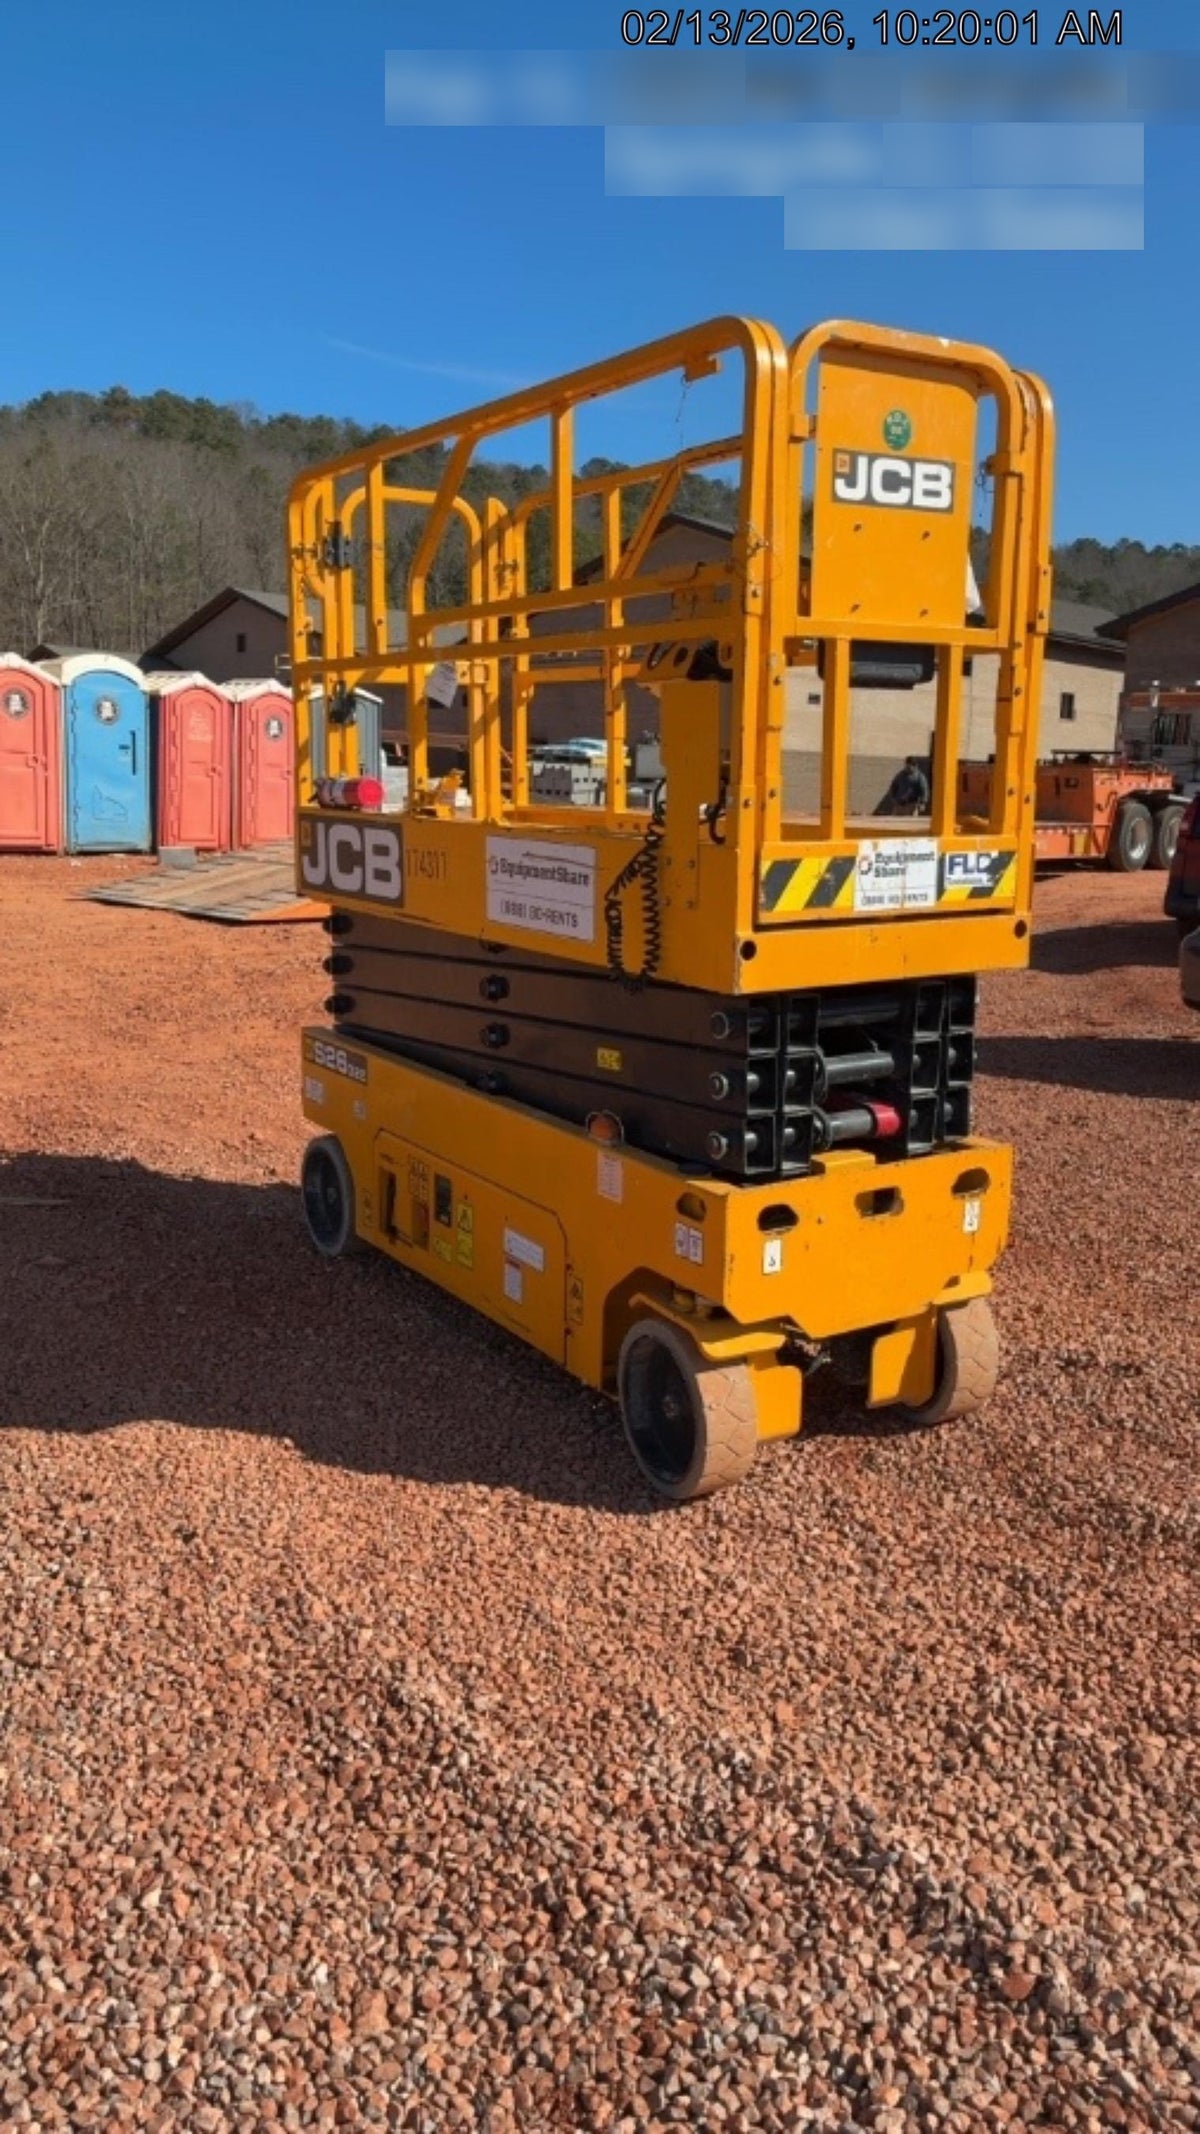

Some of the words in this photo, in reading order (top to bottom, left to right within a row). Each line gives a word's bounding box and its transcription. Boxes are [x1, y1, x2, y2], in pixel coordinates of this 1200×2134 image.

[834, 455, 952, 509] JCB
[303, 821, 402, 899] JCB
[499, 857, 590, 887] EquipmentShare
